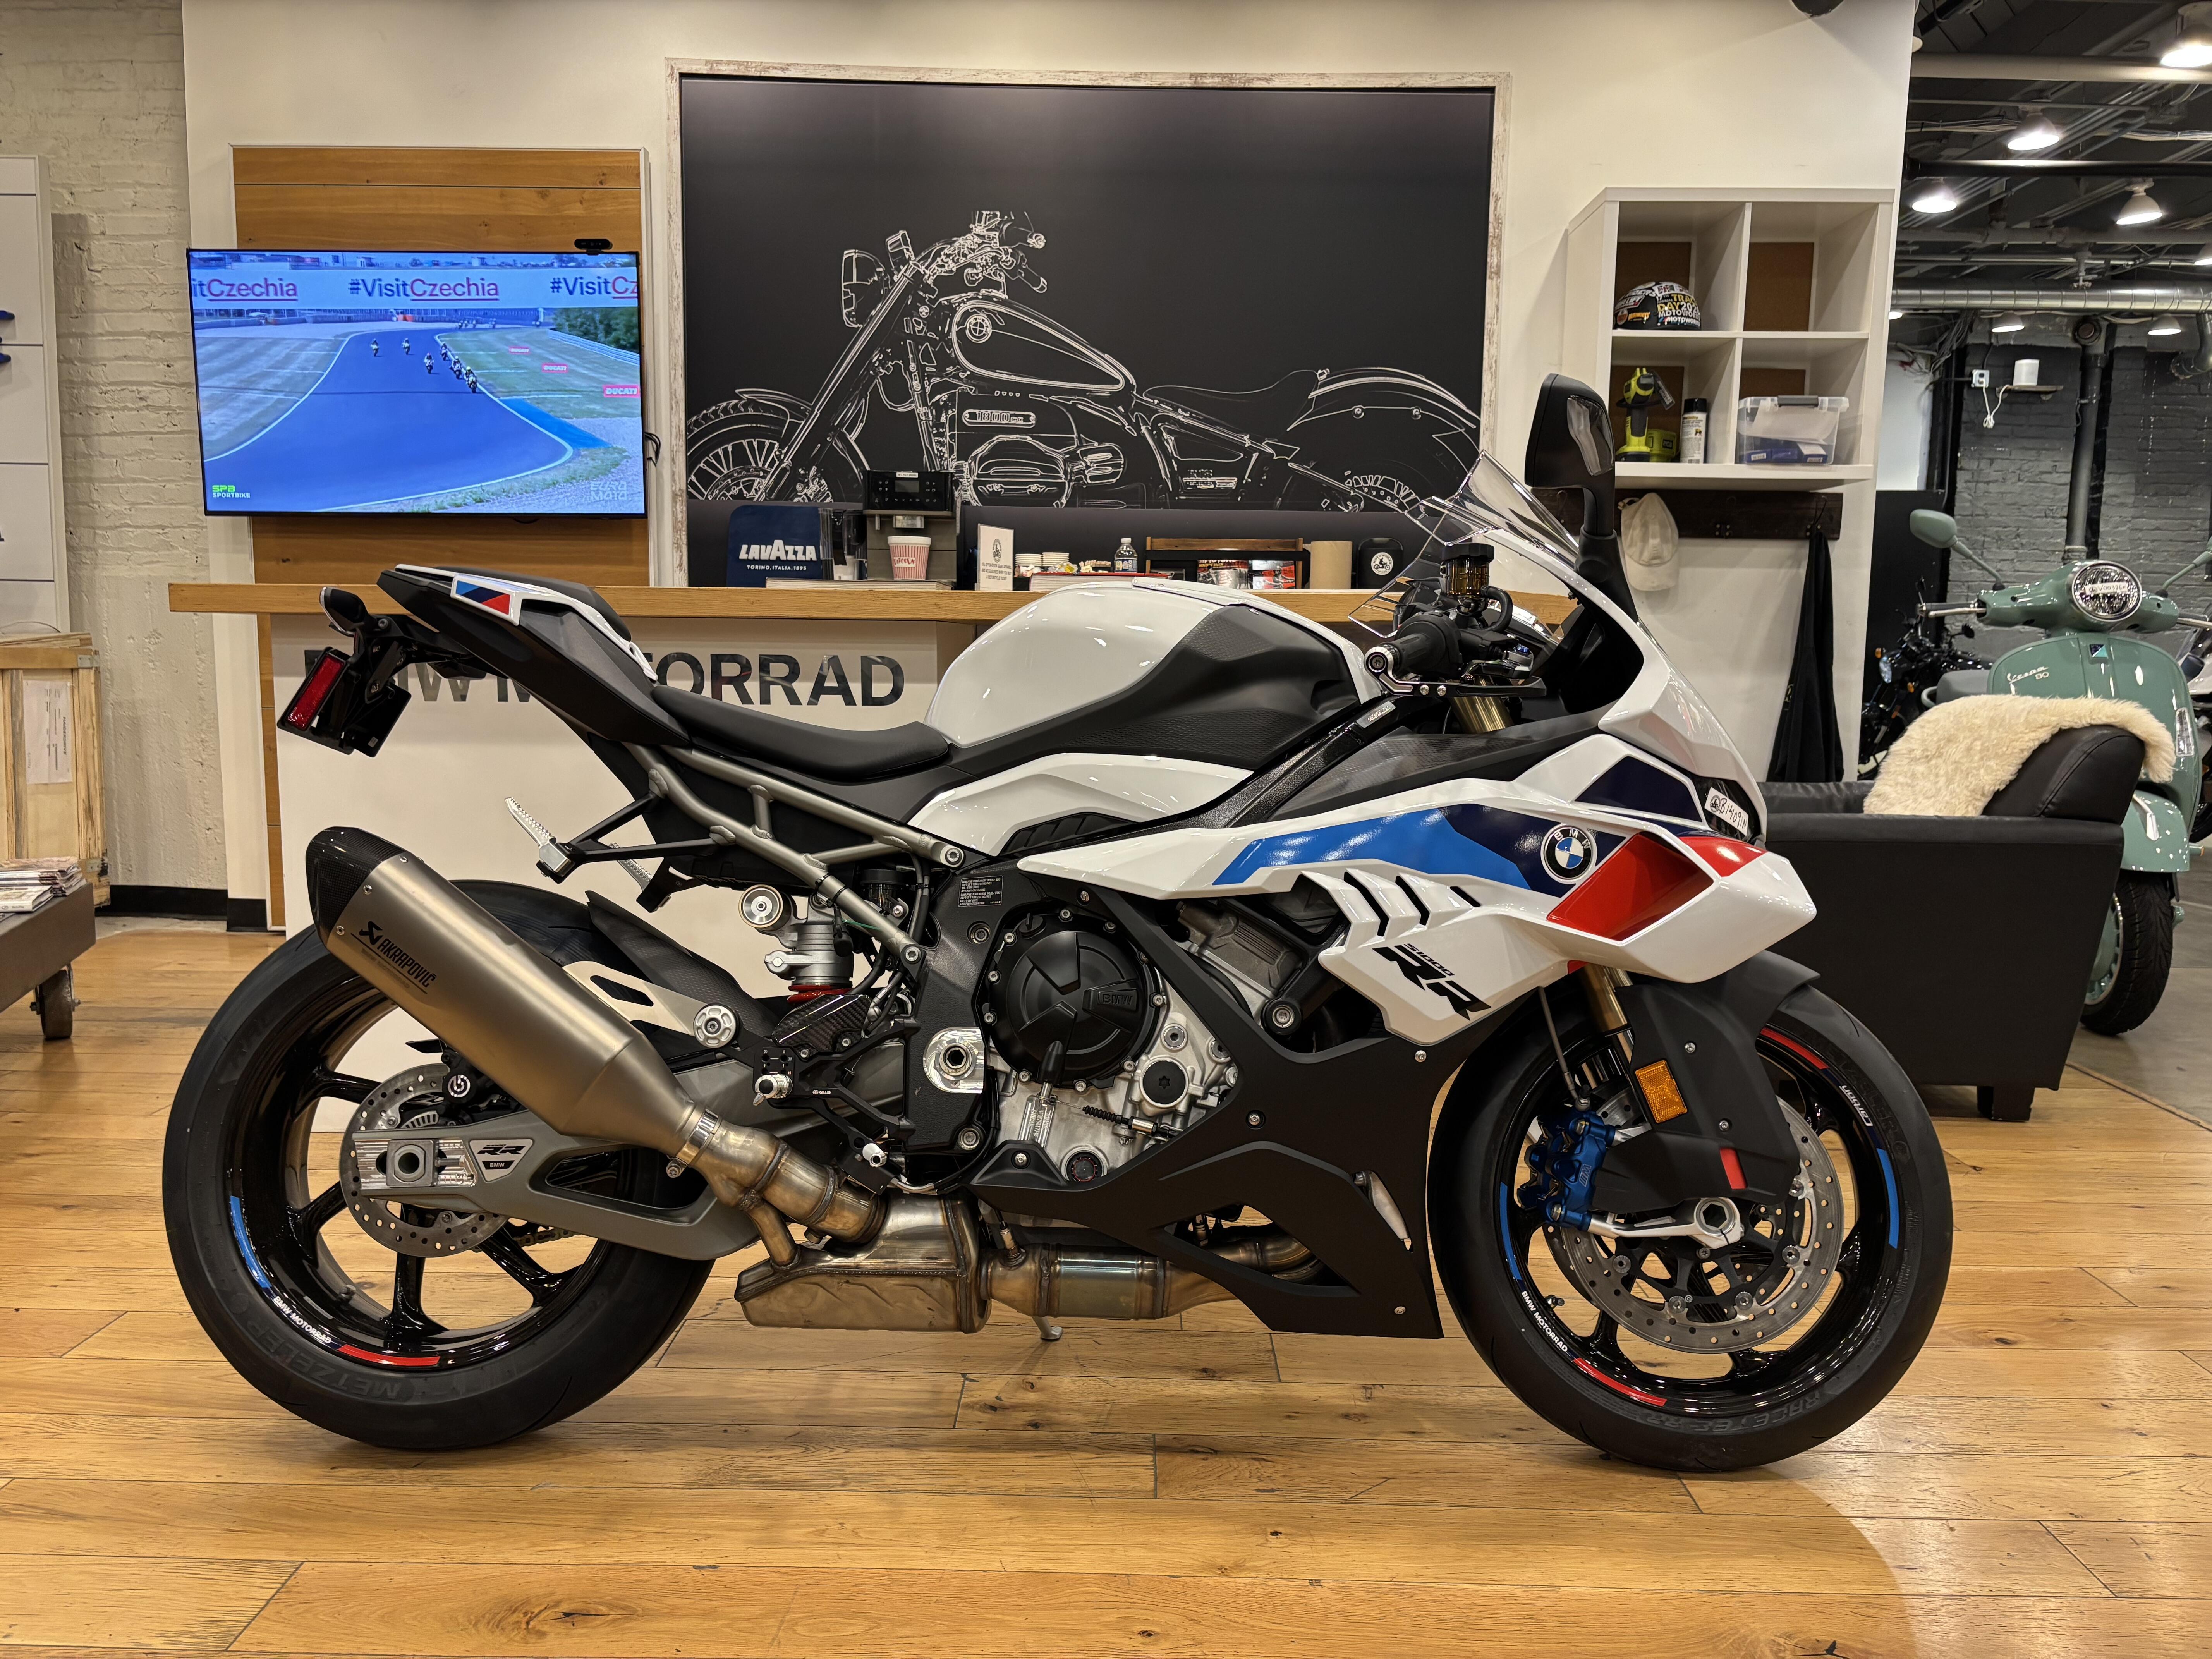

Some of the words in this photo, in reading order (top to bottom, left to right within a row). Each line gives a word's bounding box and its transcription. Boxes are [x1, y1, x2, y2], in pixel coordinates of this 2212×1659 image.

[349, 277, 499, 298] #VisitCzechia
[976, 411, 1024, 423] 1800cc
[738, 539, 817, 561] LAVAZZA
[2007, 666, 2049, 684] Vespa
[1553, 829, 1591, 849] BMW
[377, 938, 437, 988] AKRAPOVIČ
[1404, 943, 1455, 976] S1000
[1372, 945, 1492, 1021] RR
[1103, 994, 1133, 1005] BMW
[1839, 1085, 1873, 1126] Carbon
[477, 1146, 526, 1156] RR
[273, 1295, 292, 1314] BMW
[289, 1312, 333, 1344] MOTORRAD
[1521, 1290, 1537, 1312] BMW
[1534, 1312, 1568, 1352] MOTORRAD
